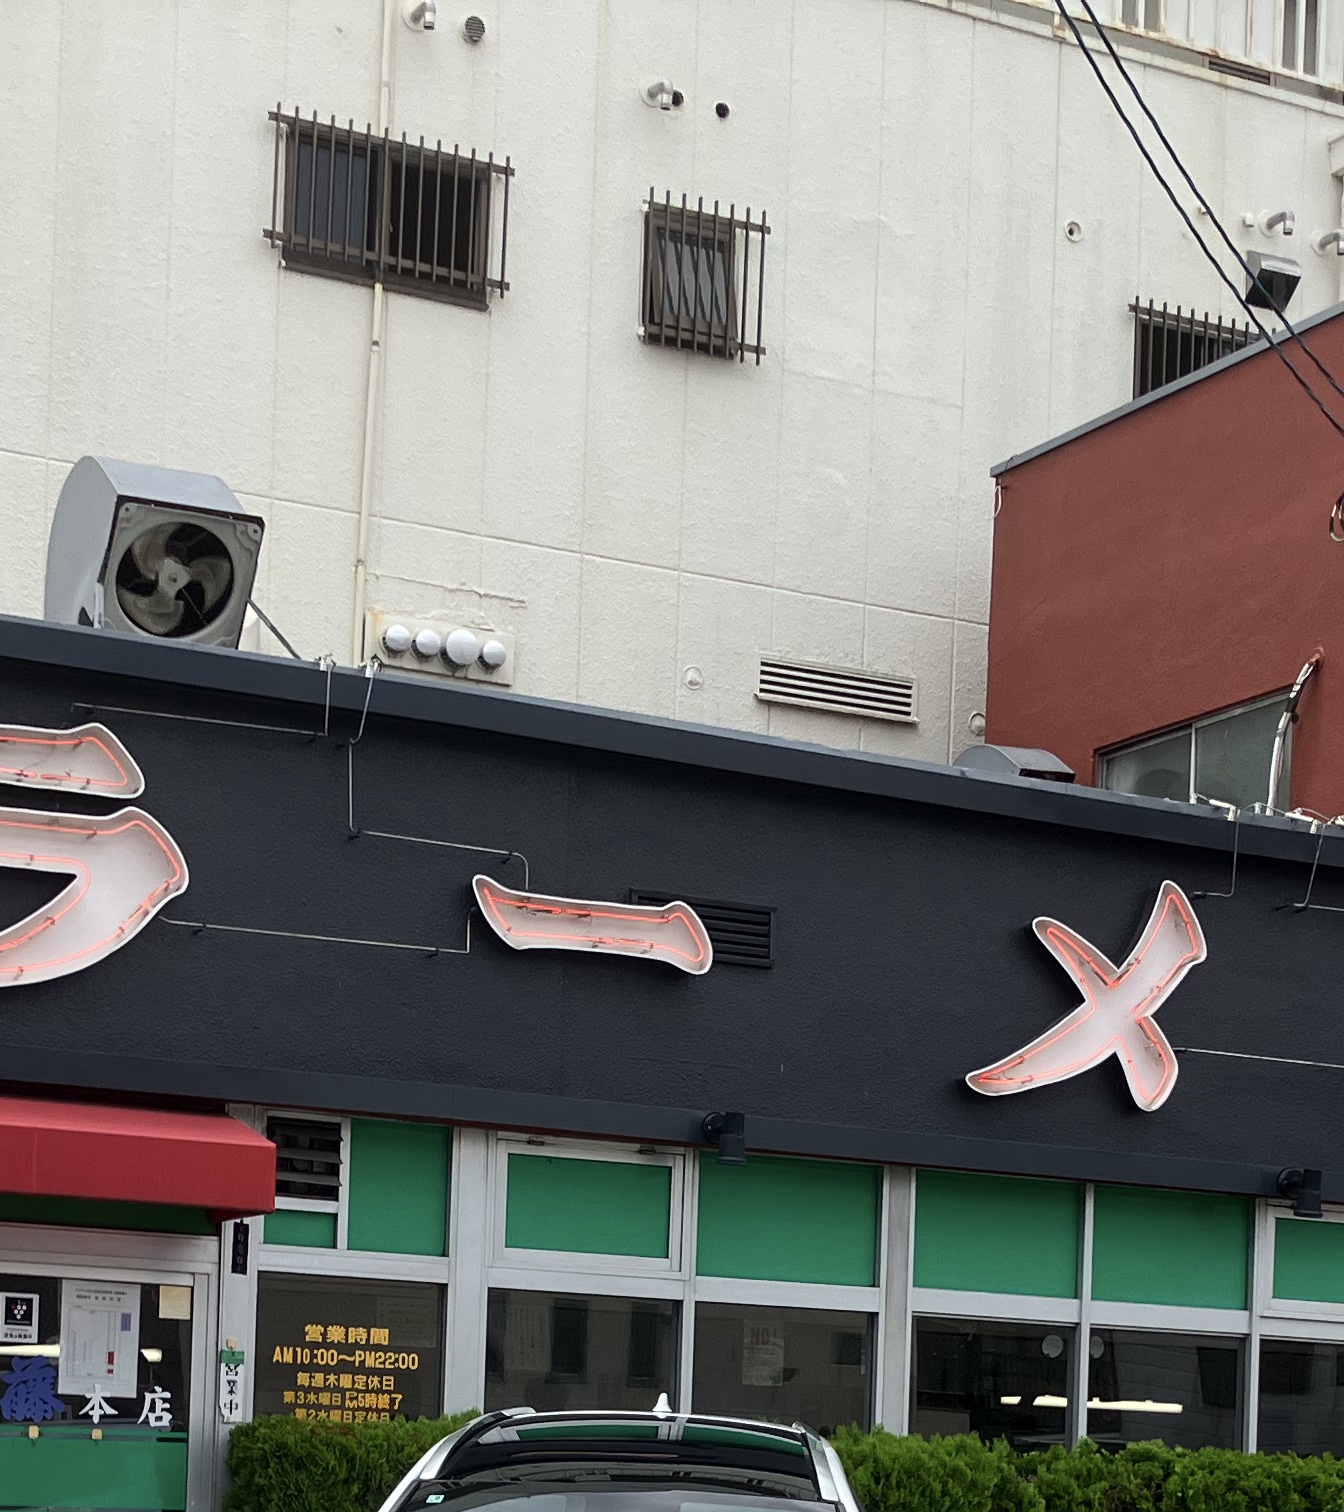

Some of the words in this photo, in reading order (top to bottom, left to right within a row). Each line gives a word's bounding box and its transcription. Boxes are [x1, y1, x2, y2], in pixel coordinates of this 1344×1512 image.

[304, 1323, 390, 1346] 営業時間
[296, 1371, 395, 1391] 毎週木曜定休日
